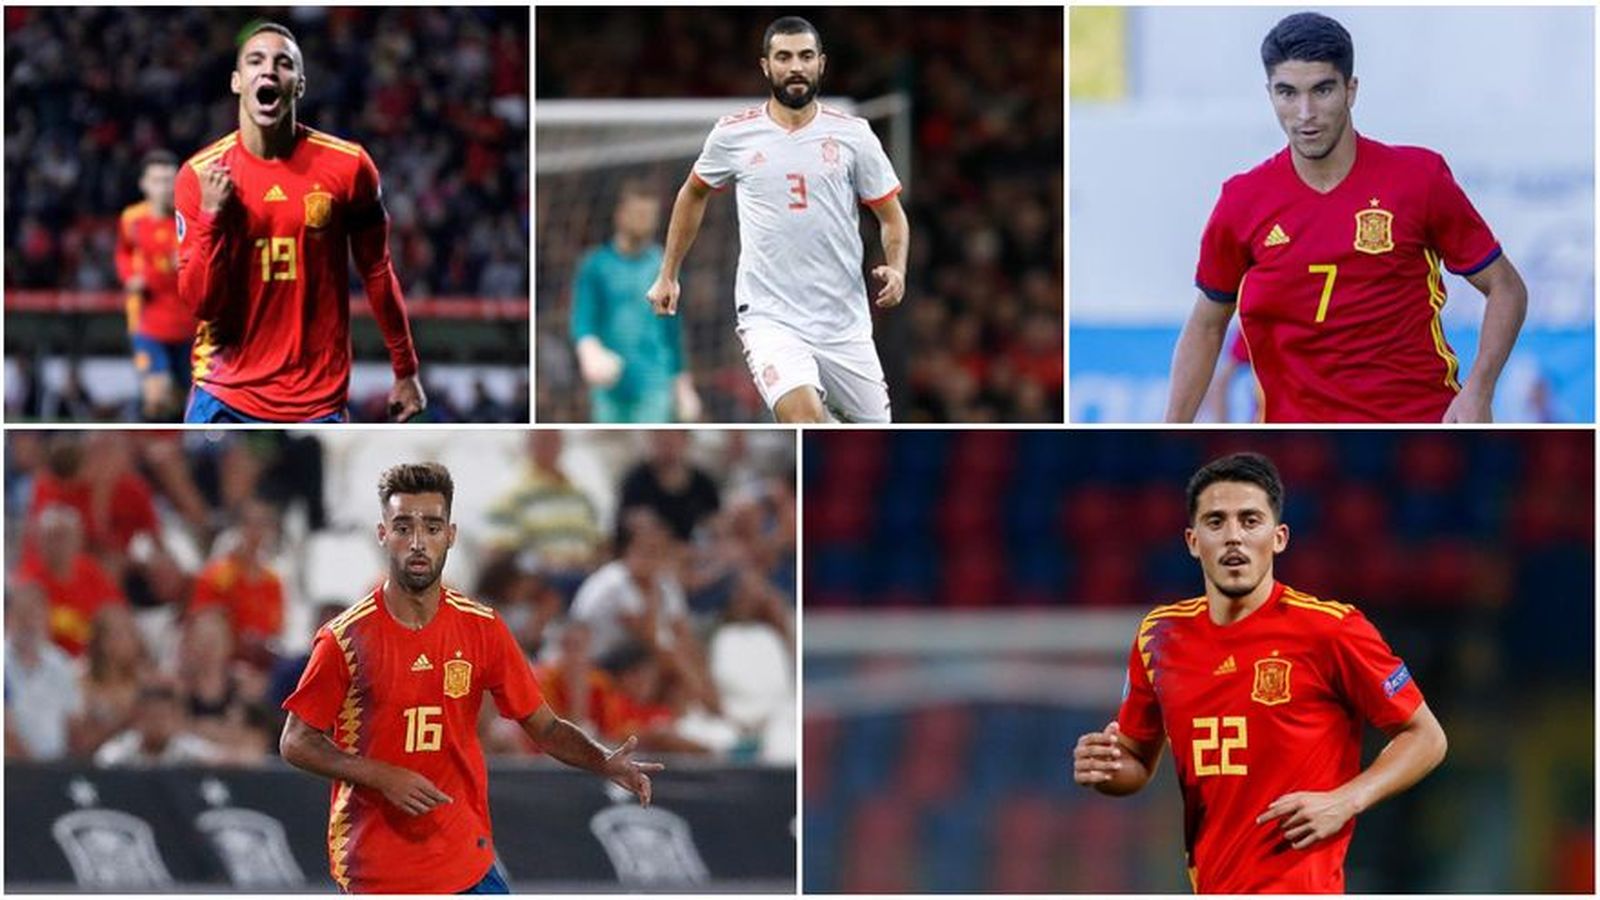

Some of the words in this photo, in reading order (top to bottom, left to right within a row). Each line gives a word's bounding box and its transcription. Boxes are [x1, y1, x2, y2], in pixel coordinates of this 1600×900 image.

[787, 174, 808, 210] 3
[255, 236, 297, 283] 19
[1308, 264, 1338, 323] 7
[403, 706, 443, 754] 16
[1192, 716, 1248, 777] 22
